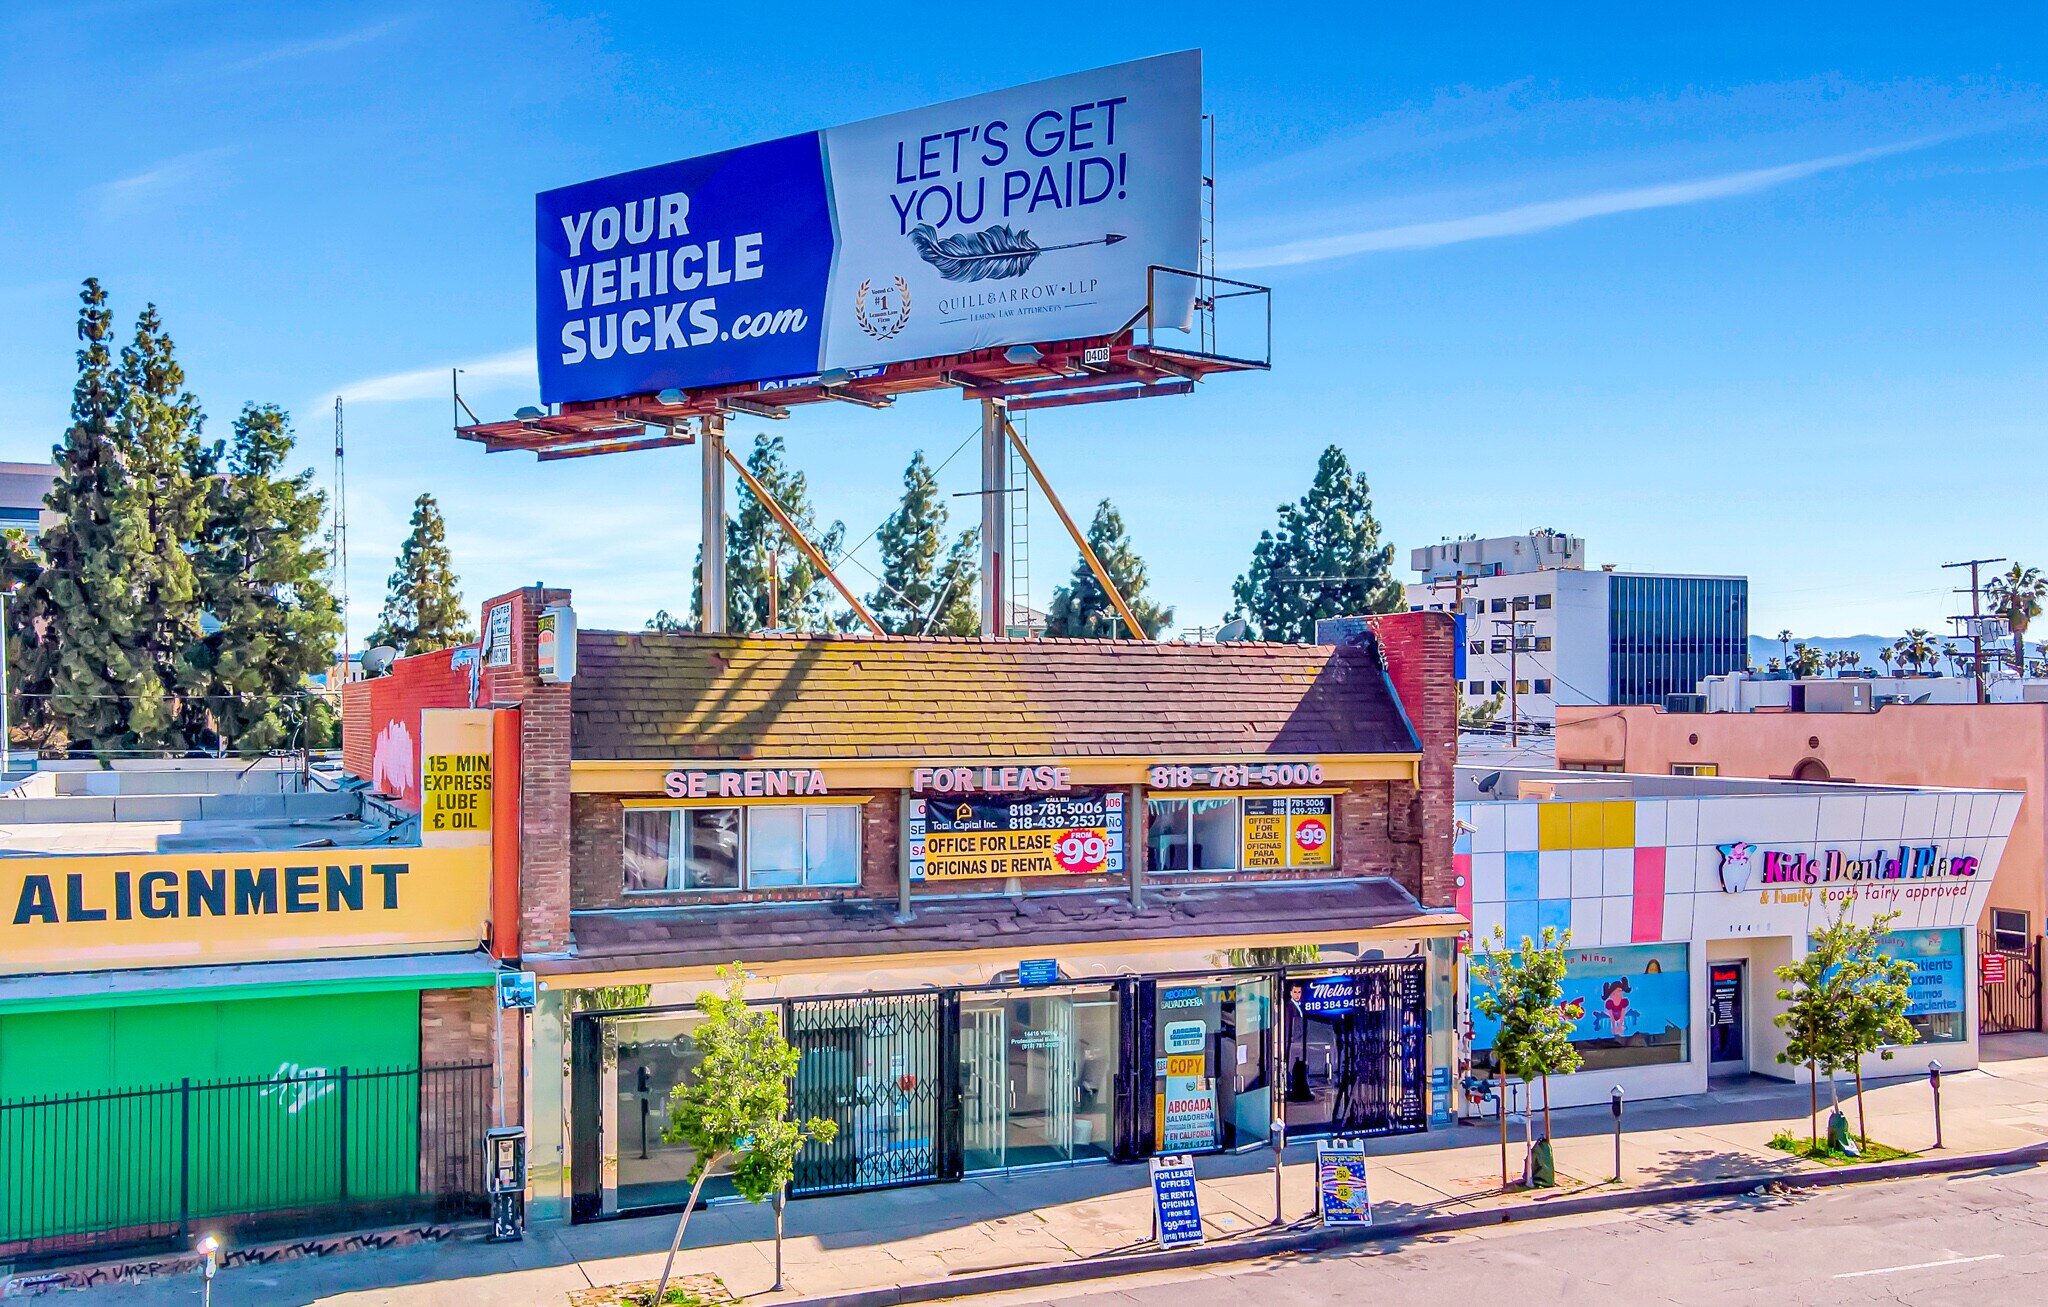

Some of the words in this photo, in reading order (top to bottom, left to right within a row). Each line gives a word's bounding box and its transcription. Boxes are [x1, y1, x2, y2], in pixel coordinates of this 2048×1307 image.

[897, 121, 1008, 184] LET'S
[1026, 97, 1127, 157] GET
[890, 177, 984, 235] YOU
[1004, 153, 1127, 216] PAID!
[561, 192, 689, 257] YOUR
[561, 232, 764, 311] VEHICLE
[874, 295, 888, 310] #1
[561, 297, 807, 365] SUCKS.com
[1085, 348, 1109, 362] 0408
[428, 755, 448, 772] 15
[423, 774, 492, 791] EXPRESS
[665, 771, 708, 798] SE
[719, 769, 828, 797] RENTA
[914, 767, 975, 793] FOR
[982, 765, 1072, 791] LEASE
[1151, 763, 1325, 789] 818-781-5006
[436, 793, 478, 810] LUBE
[1009, 801, 1103, 817] 818-781-5006
[452, 812, 478, 828] OIL
[931, 821, 952, 830] Total
[953, 819, 982, 832] Capital
[983, 820, 998, 829] Inc.
[1008, 814, 1106, 830] 818-439-2537
[1248, 817, 1280, 825] OFFICES
[928, 837, 976, 853] OFFICE
[980, 836, 1006, 851] FOR
[1009, 834, 1052, 850] LEASE
[1070, 831, 1093, 839] FROM
[1295, 828, 1327, 845] $99
[1053, 837, 1107, 865] $99
[927, 860, 988, 876] OFICINAS
[991, 859, 1007, 873] DE
[1011, 857, 1053, 872] RENTA
[1761, 850, 1821, 883] Kids
[1823, 845, 1910, 881] Dental
[1909, 844, 1979, 879] Place
[12, 863, 410, 925] ALIGNMENT
[1759, 890, 1769, 905] &
[1773, 887, 1813, 907] Family
[1865, 882, 1899, 901] fairy
[1905, 880, 1969, 901] approved
[1211, 990, 1236, 1003] TAX
[1305, 1001, 1322, 1011] 818
[1323, 999, 1341, 1009] 384
[1170, 1058, 1202, 1074] COPY
[1167, 1097, 1212, 1114] ABOGADA
[1155, 1172, 1170, 1180] FOR
[1171, 1169, 1194, 1179] LEASE
[1160, 1180, 1190, 1188] OFFICES
[1160, 1192, 1170, 1200] SE
[1171, 1190, 1194, 1199] RENTA
[1161, 1199, 1195, 1210] OFICINAS
